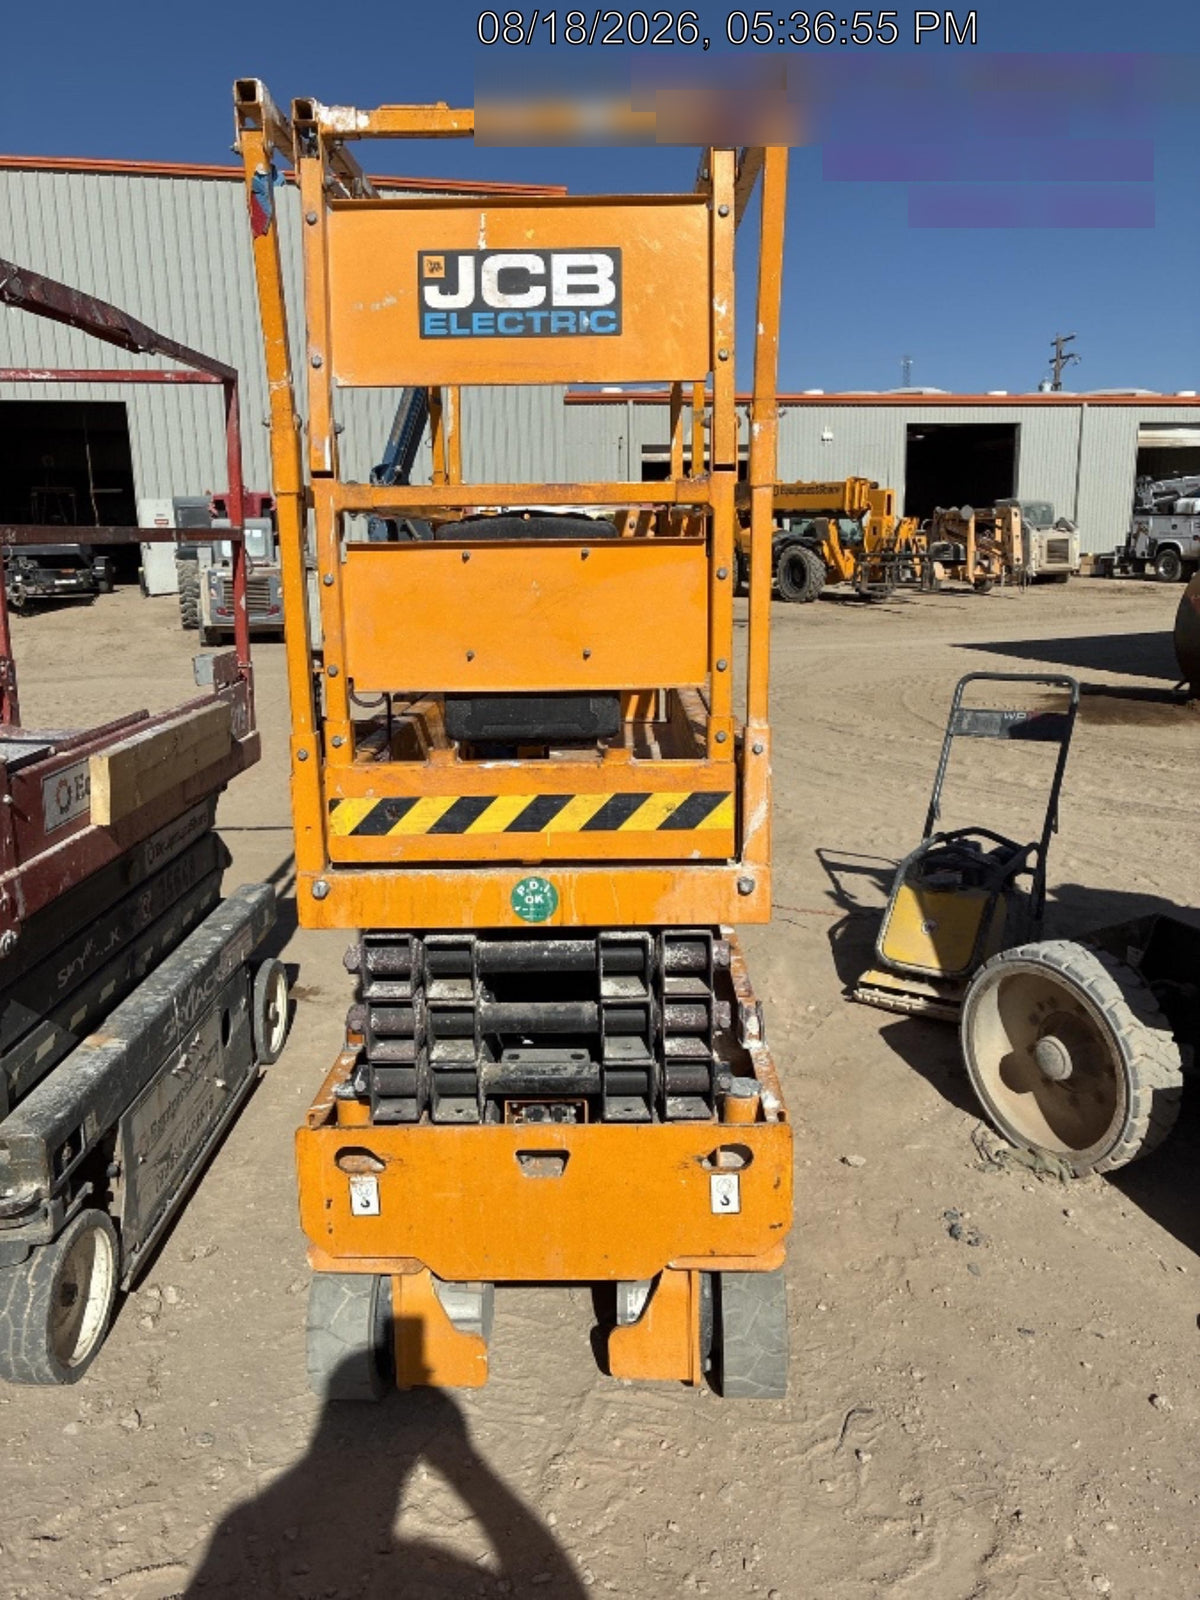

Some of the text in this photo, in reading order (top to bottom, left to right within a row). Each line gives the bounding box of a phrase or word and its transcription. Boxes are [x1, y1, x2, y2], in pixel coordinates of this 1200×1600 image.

[423, 254, 617, 309] JCB
[424, 310, 617, 335] ELECTRIC
[524, 894, 545, 904] OK
